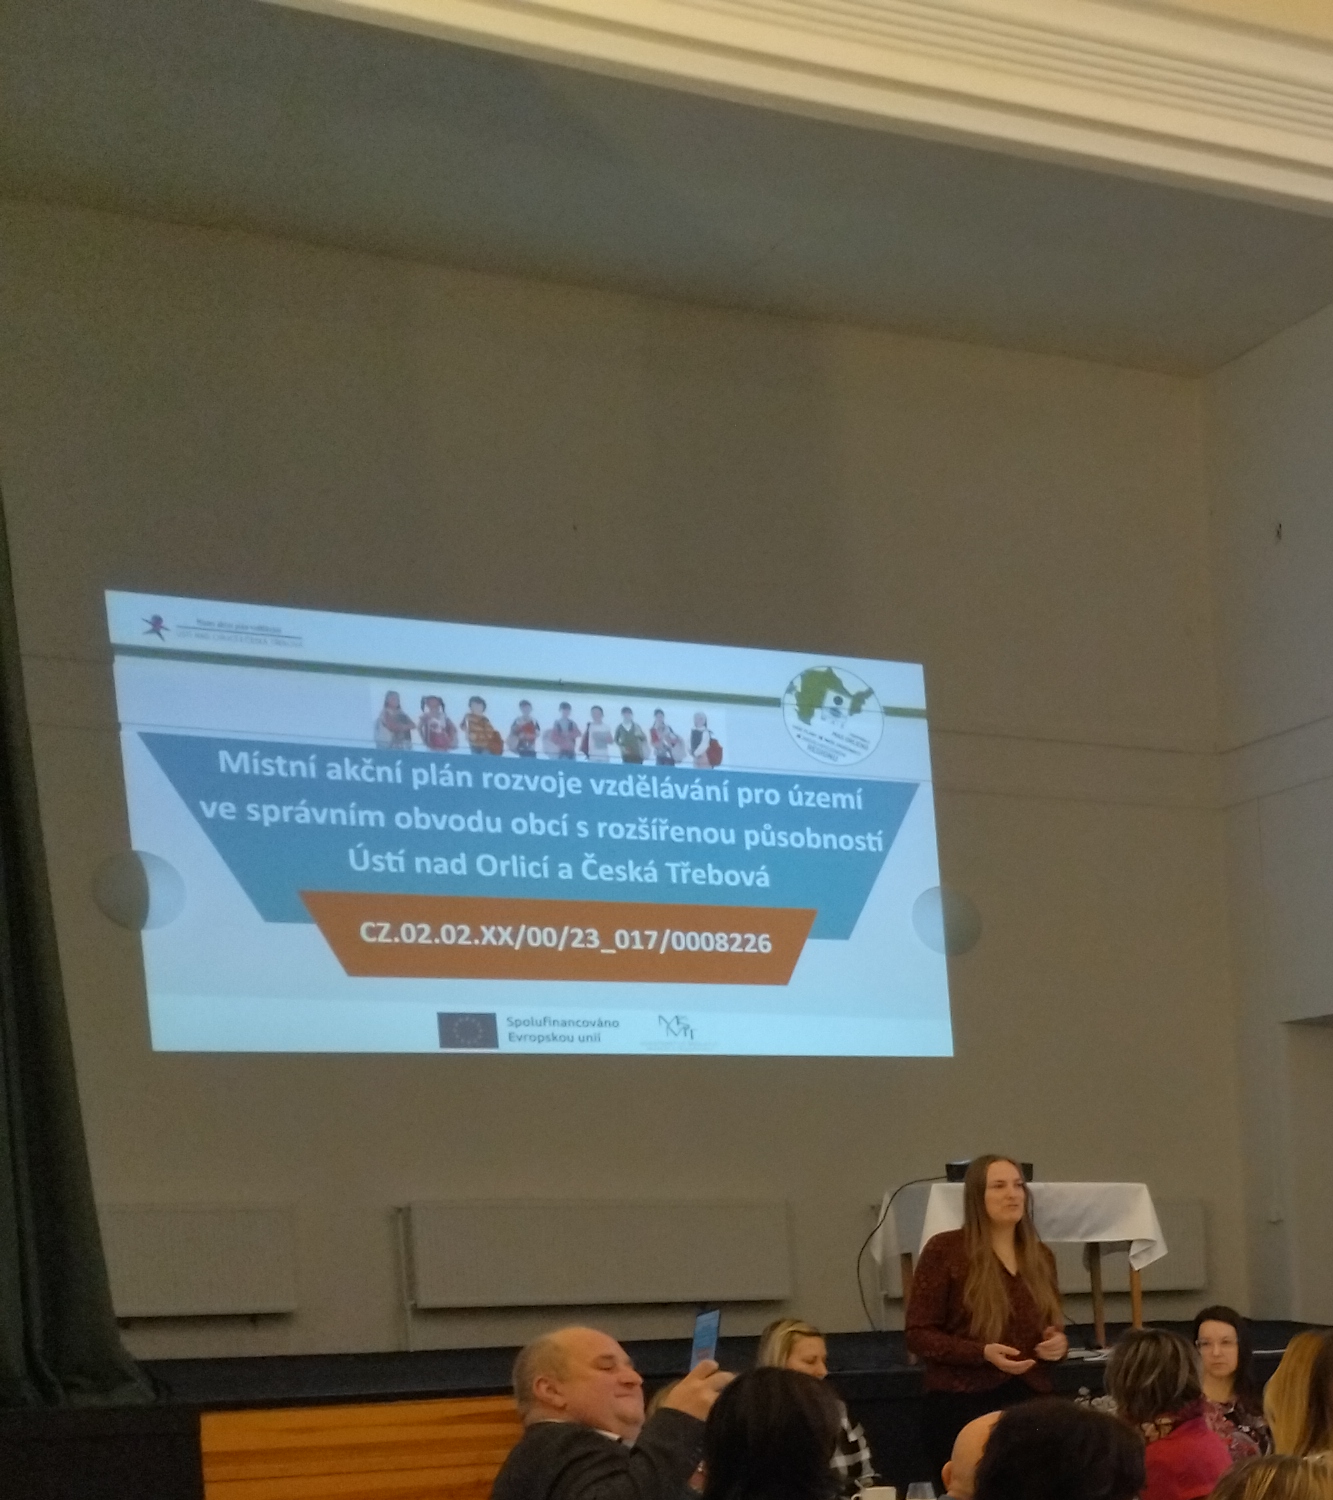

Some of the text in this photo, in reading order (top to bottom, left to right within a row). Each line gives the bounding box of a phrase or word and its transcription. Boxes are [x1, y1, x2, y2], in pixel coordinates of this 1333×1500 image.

[217, 749, 863, 810] Místní akční plán rozvoje vzdělávání pro území
[200, 799, 884, 852] ve správním obvodu obcí s rozšířenou působností
[348, 842, 770, 888] Ústí nad Orlicí a Česká Třebová
[359, 921, 773, 954] CZ.02.02.XX/00/23_017/0008226
[506, 1015, 620, 1029] Spolufinancováno
[508, 1031, 575, 1044] Evropskou
